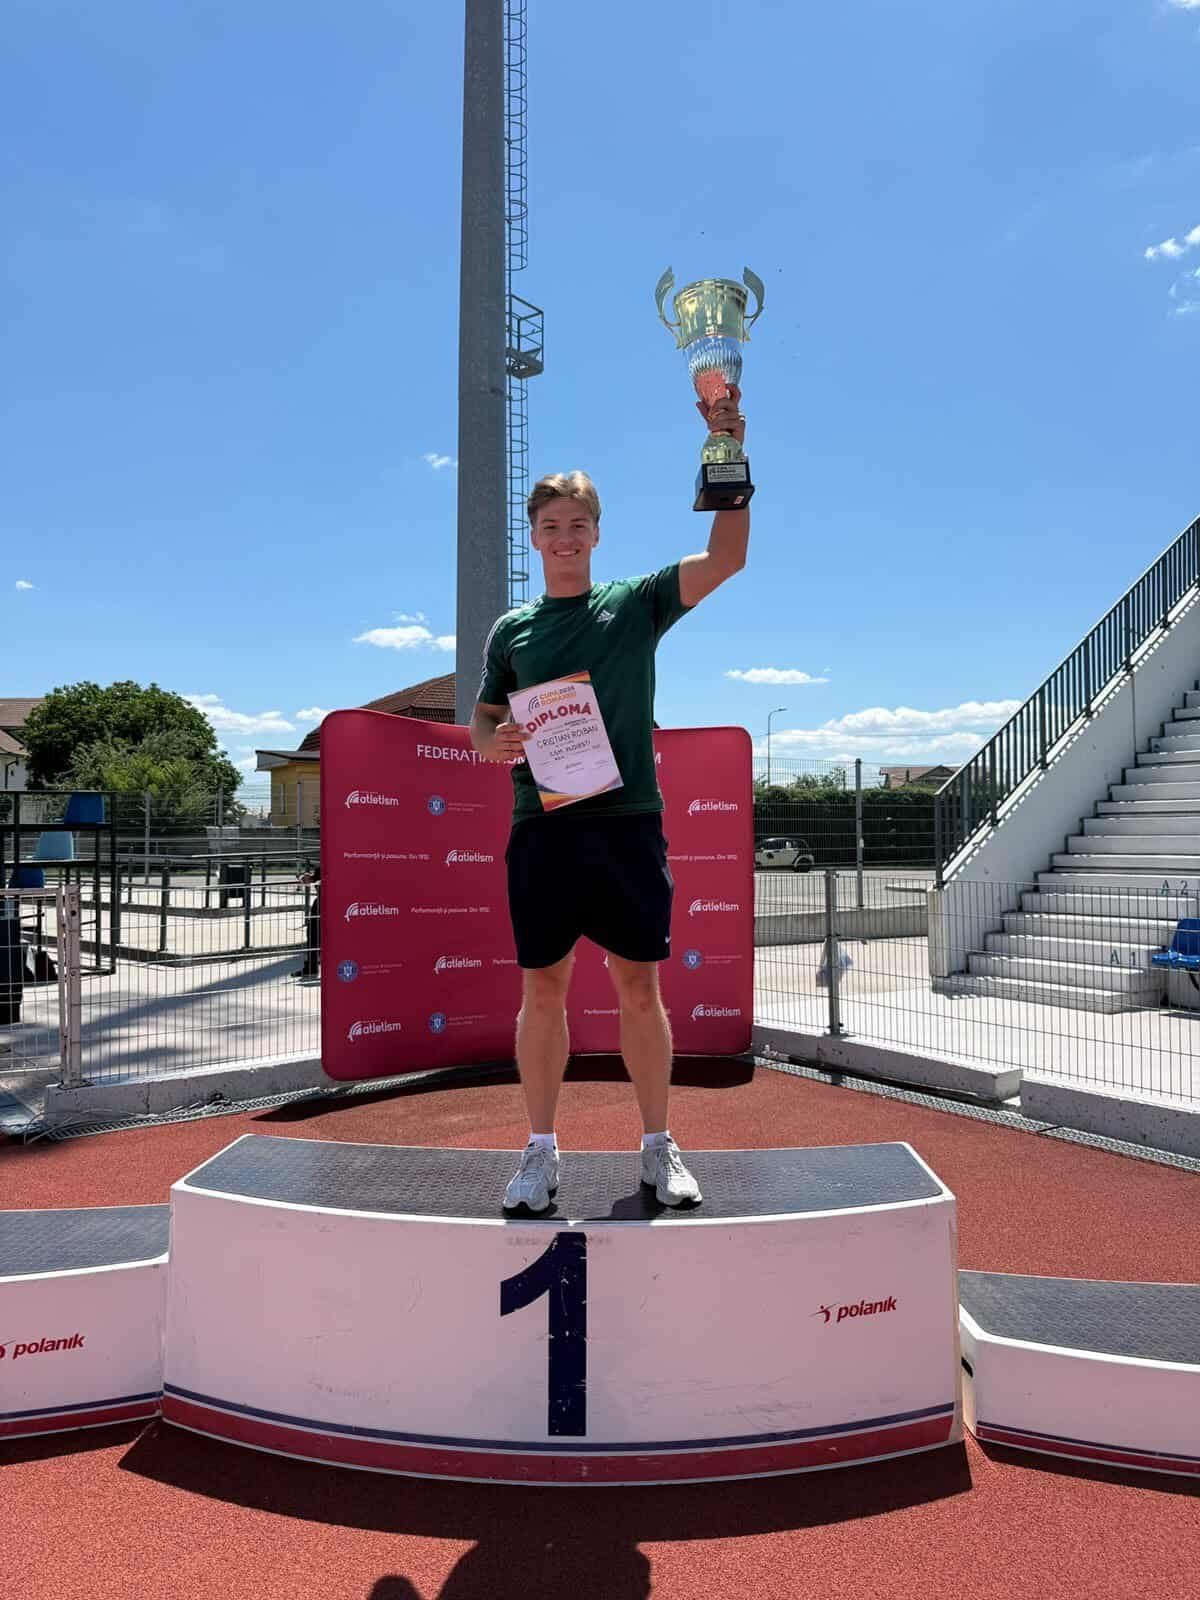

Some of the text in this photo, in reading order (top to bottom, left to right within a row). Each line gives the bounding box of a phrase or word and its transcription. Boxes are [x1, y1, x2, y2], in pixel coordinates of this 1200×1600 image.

[360, 793, 400, 806] atletism
[701, 800, 738, 811] atletism
[458, 852, 494, 863] atletism
[1180, 880, 1188, 896] 2
[360, 904, 399, 916] atletism
[702, 901, 739, 911] atletism
[446, 957, 482, 968] atletism
[1110, 949, 1120, 965] A
[705, 1007, 741, 1017] atletism
[363, 1021, 402, 1034] atletism
[836, 1295, 897, 1323] polanik
[500, 1231, 587, 1436] 1
[12, 1332, 86, 1360] polanik
